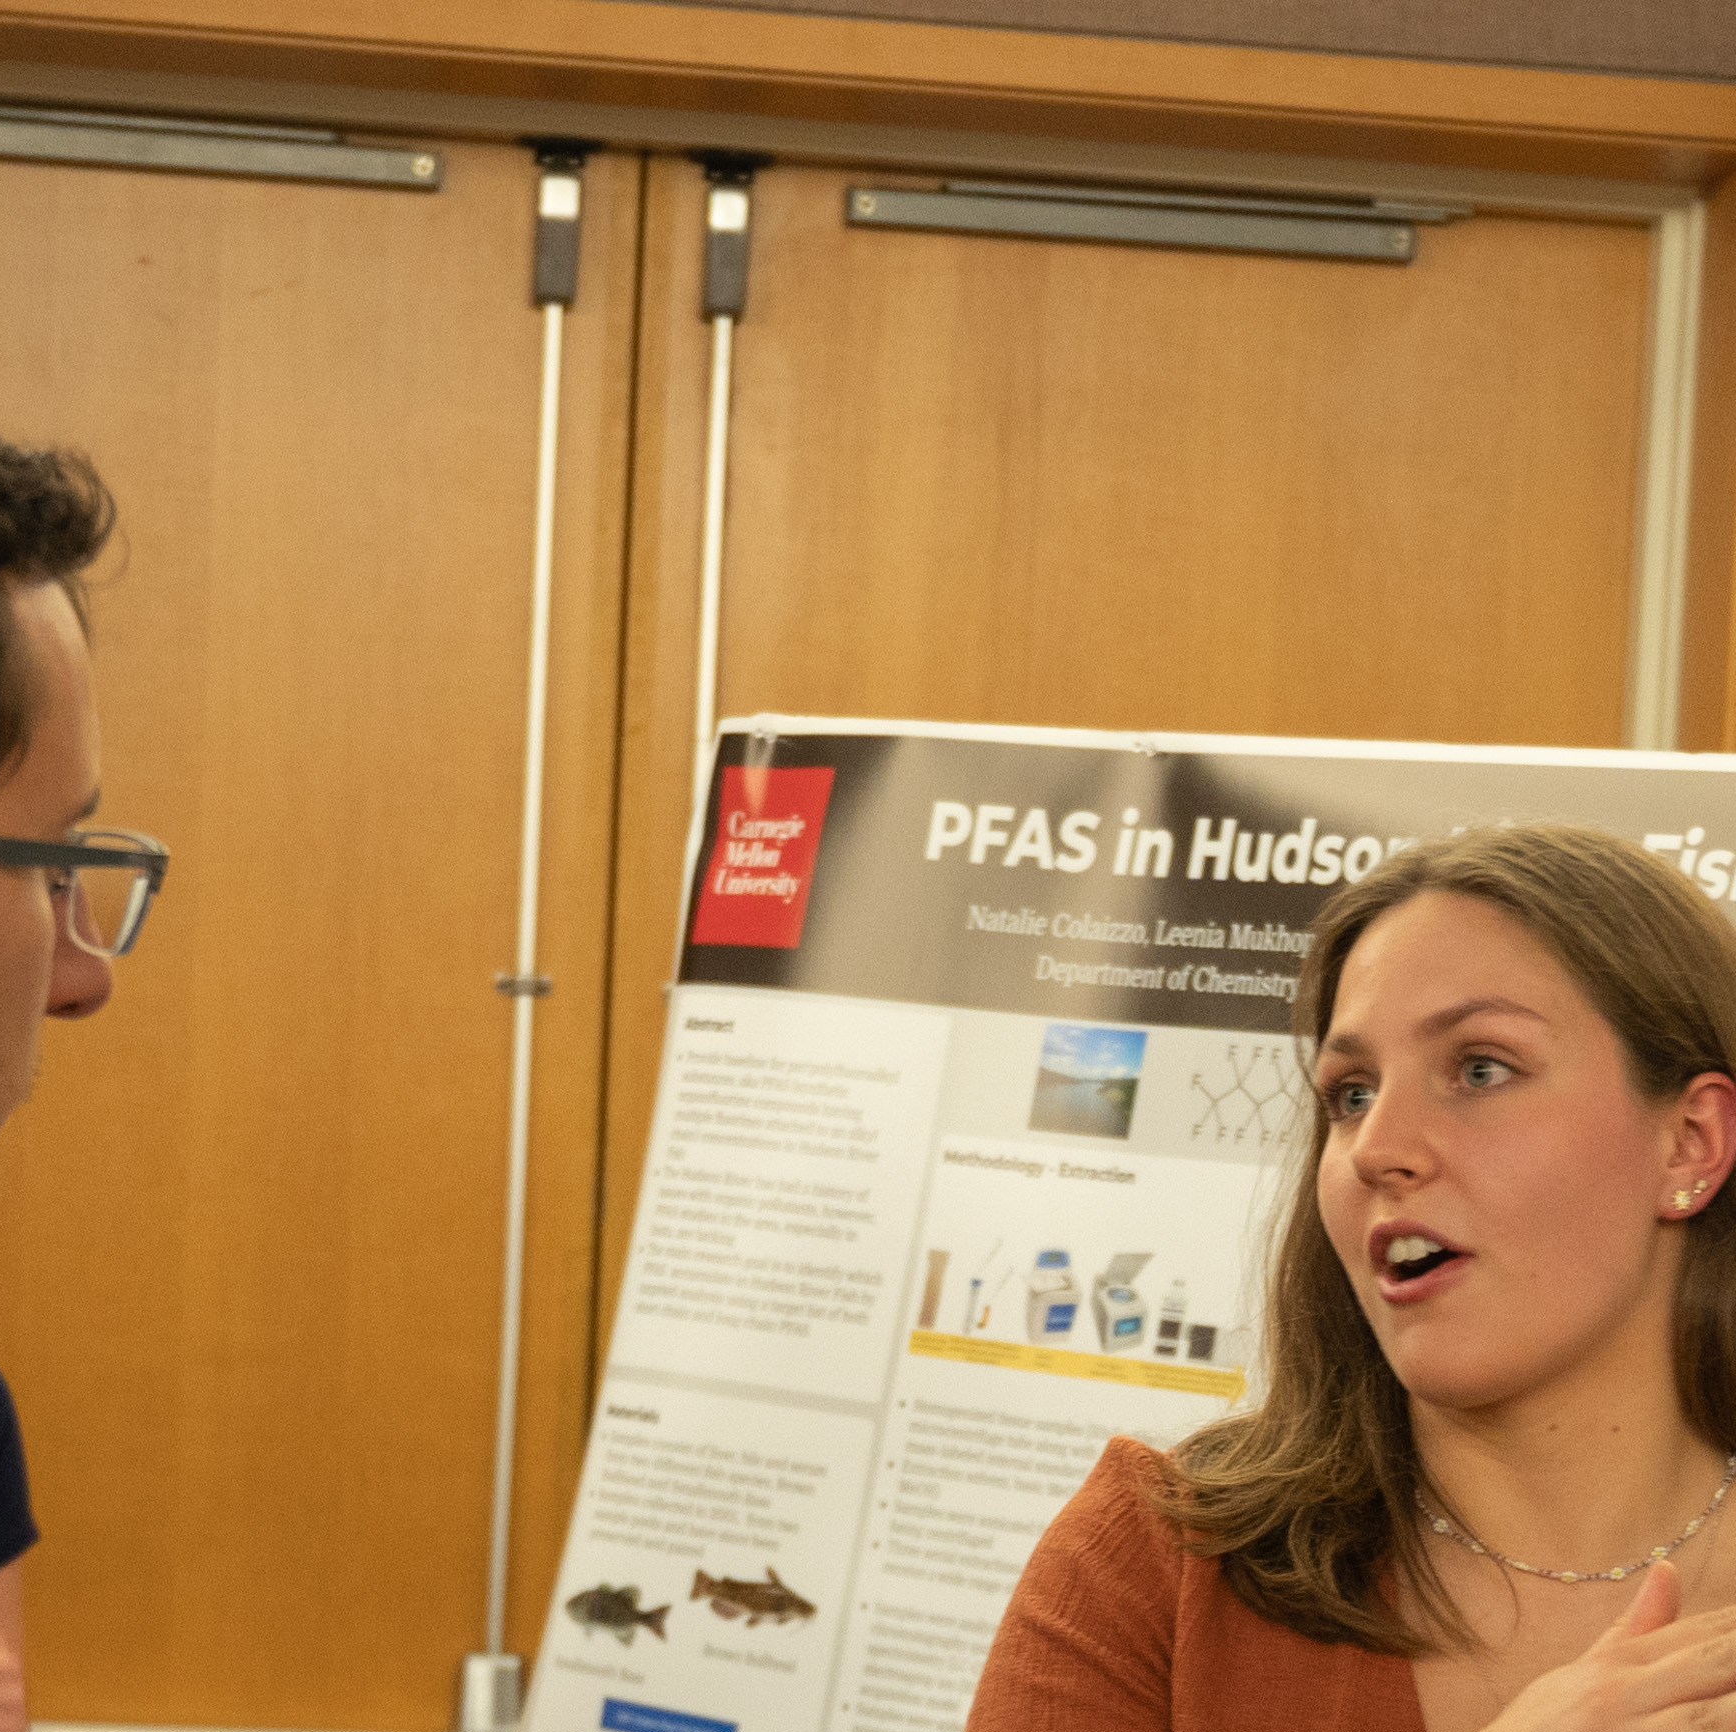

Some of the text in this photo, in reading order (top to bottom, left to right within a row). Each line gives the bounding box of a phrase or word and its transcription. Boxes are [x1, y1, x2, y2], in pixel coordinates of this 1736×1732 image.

[727, 810, 806, 846] Carnegie
[924, 801, 1101, 874] PFAS
[1113, 807, 1175, 878] in
[726, 841, 781, 868] Mellon
[714, 868, 799, 904] University
[968, 905, 1046, 937] Natalie
[1052, 914, 1149, 948] Colaizzo,
[1155, 920, 1225, 949] Leenia
[1035, 956, 1301, 1004] Department of Chemistry
[943, 1148, 1044, 1178] Methodology
[1058, 1161, 1136, 1184] Extraction
